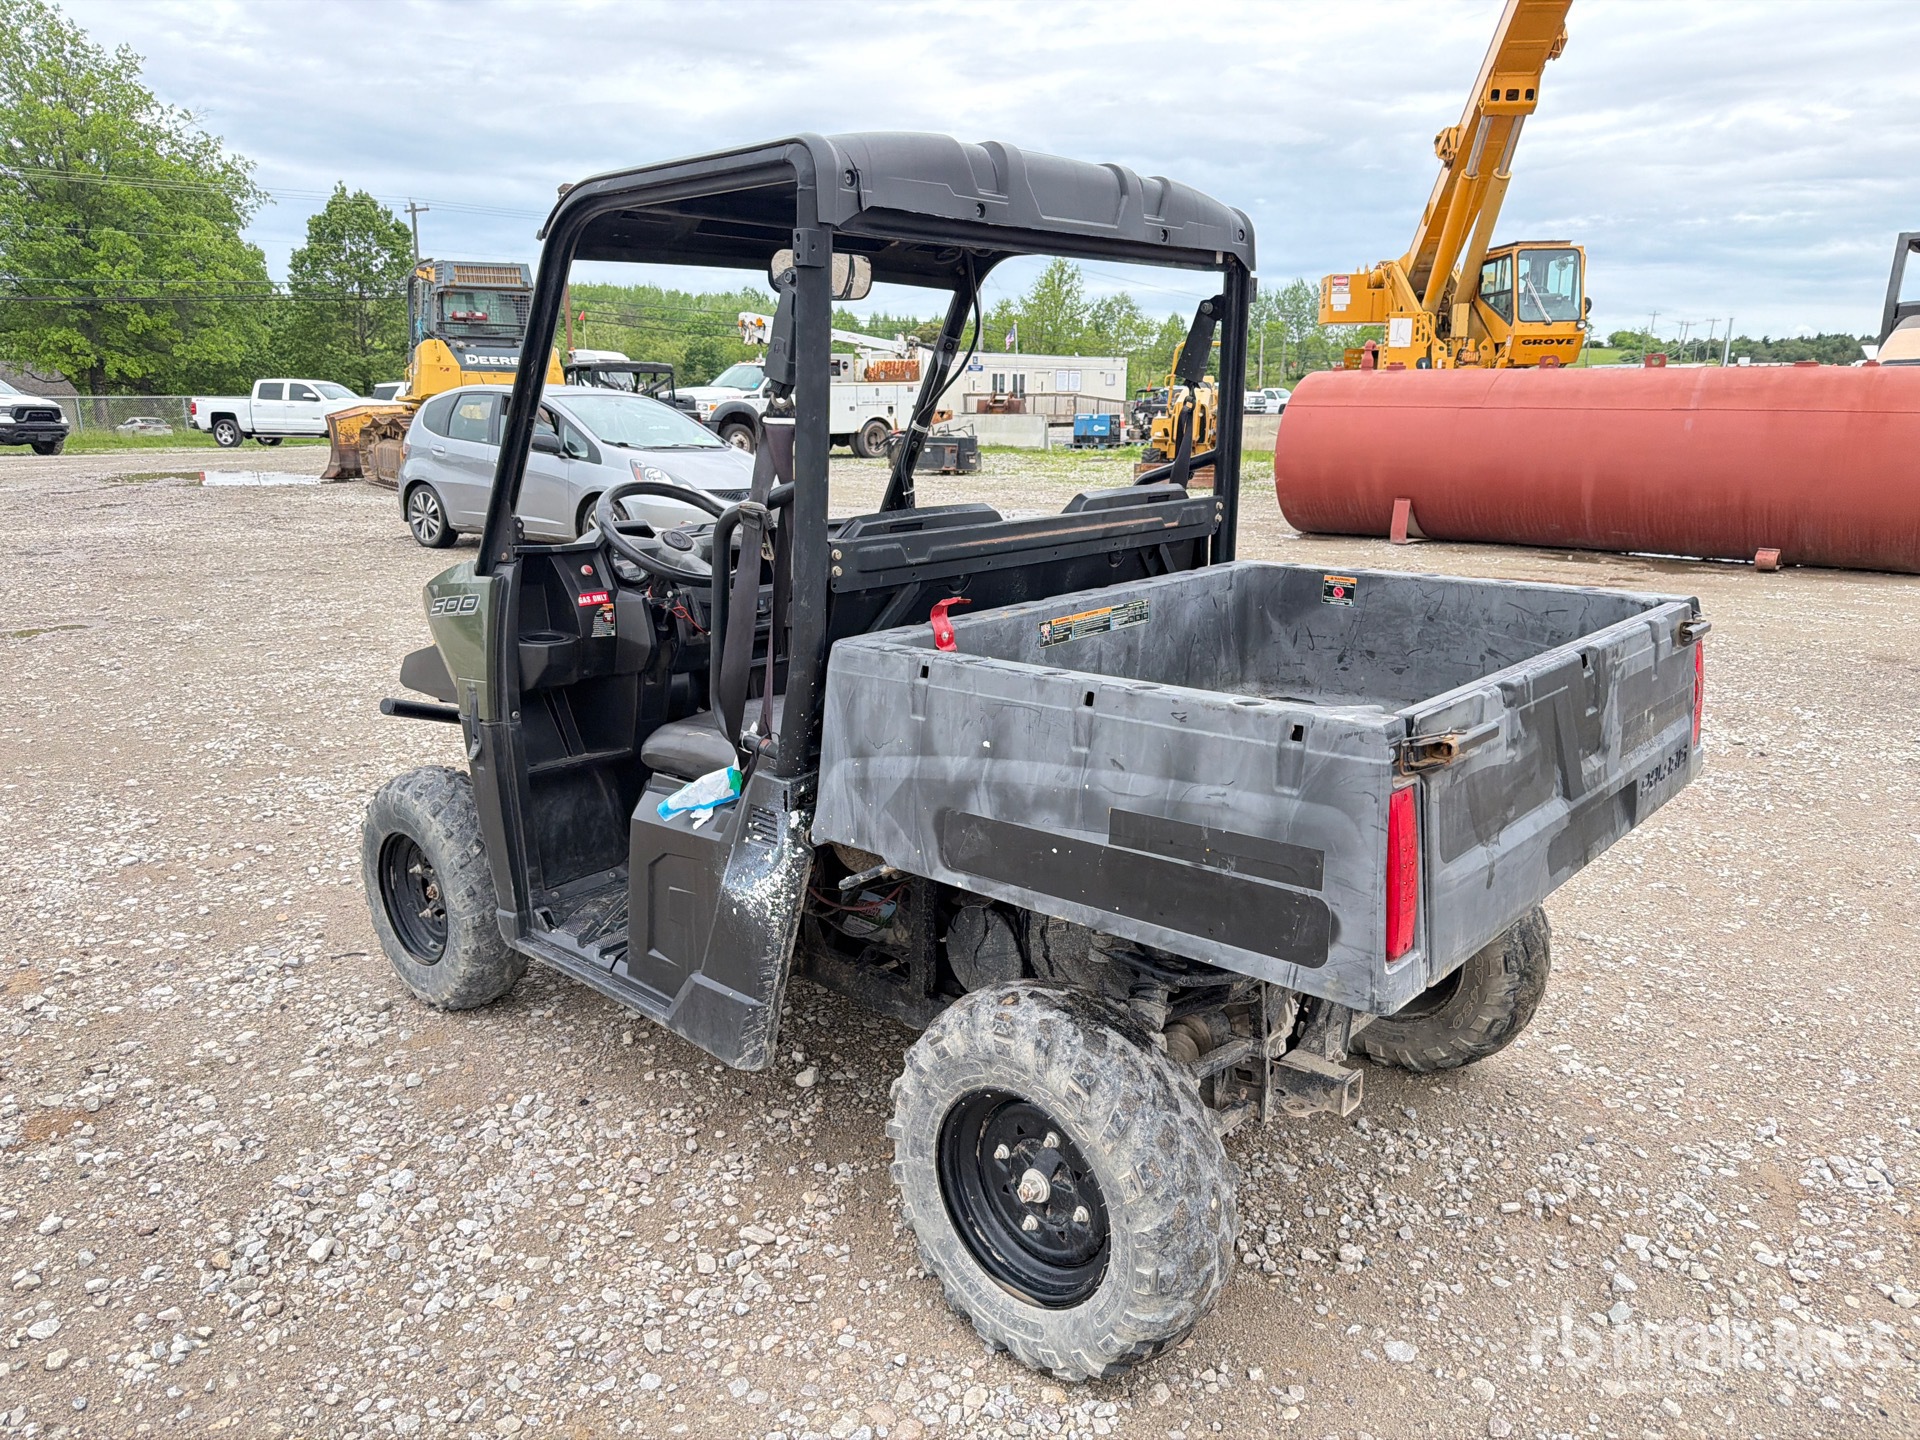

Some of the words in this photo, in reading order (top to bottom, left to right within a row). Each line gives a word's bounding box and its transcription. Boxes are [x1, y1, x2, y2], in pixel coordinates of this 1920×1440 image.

[1521, 338, 1575, 346] GROVE
[464, 353, 520, 366] DEERE
[578, 594, 592, 604] GAS
[592, 593, 608, 603] ONLY
[430, 593, 481, 617] 500
